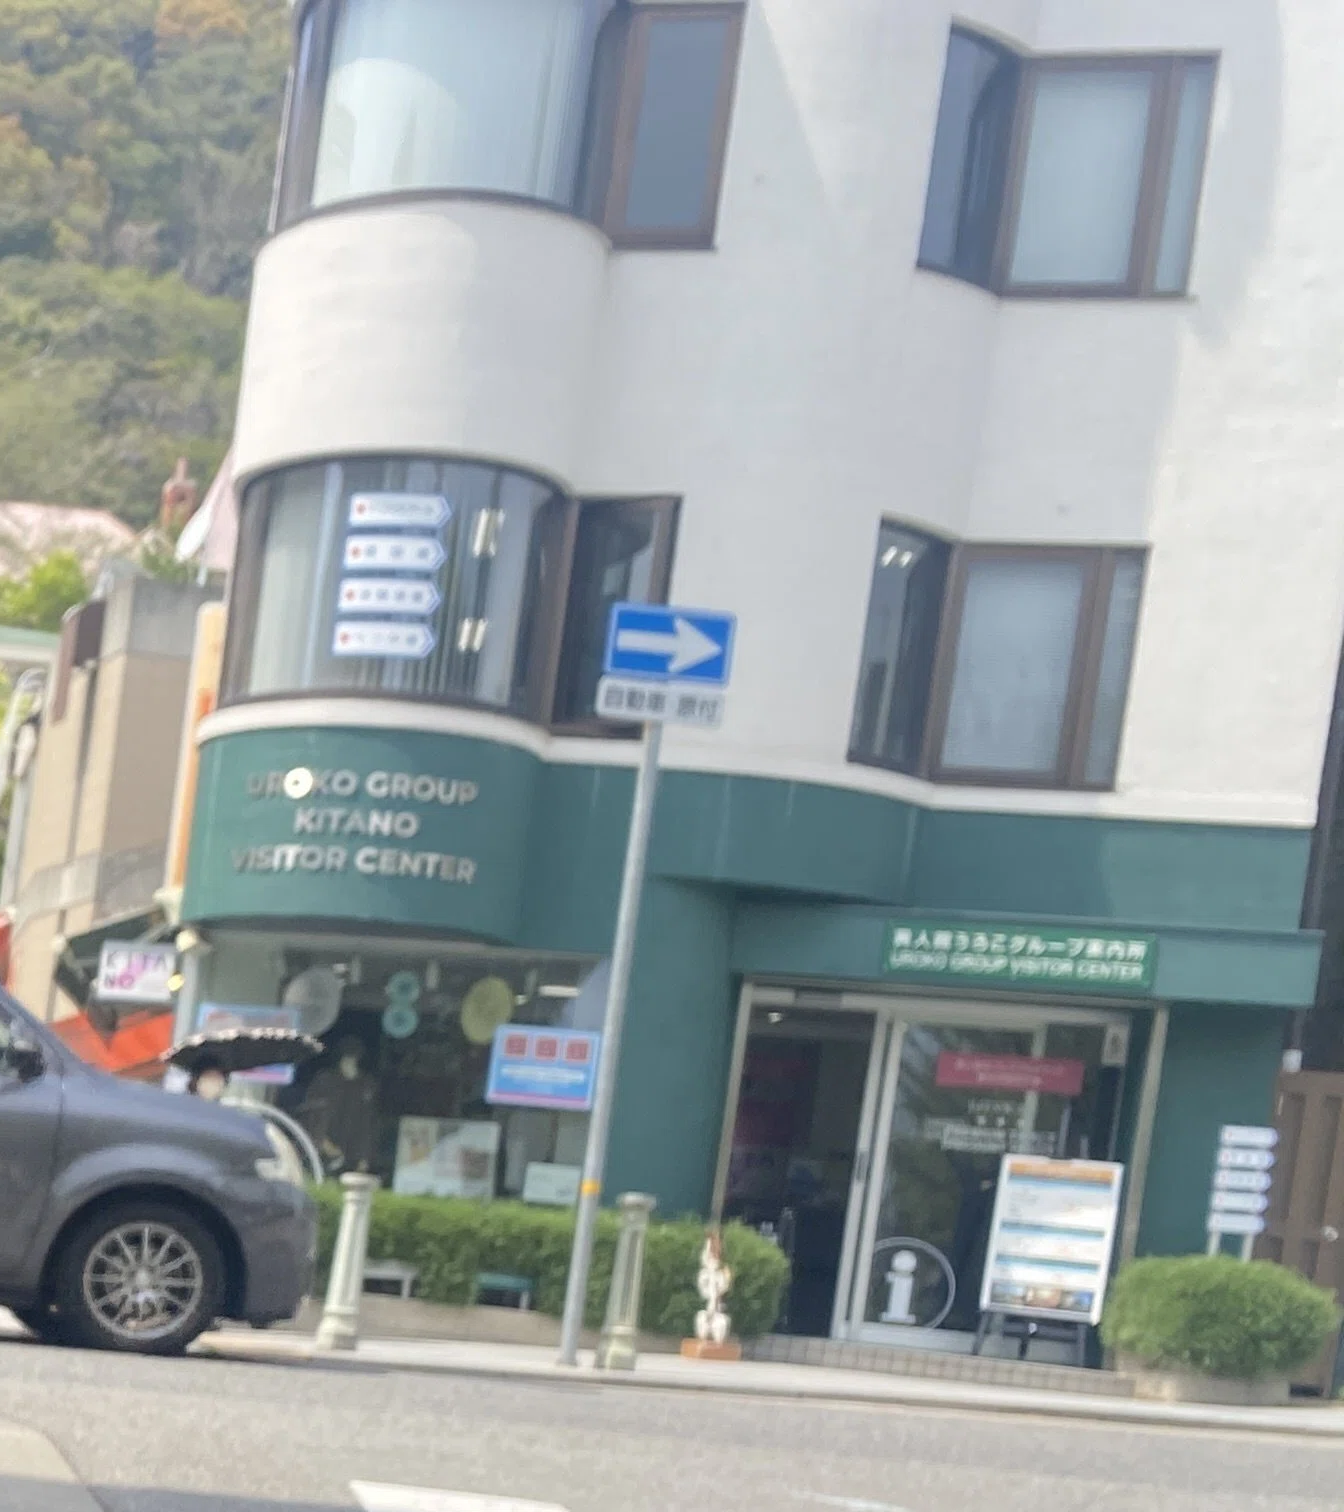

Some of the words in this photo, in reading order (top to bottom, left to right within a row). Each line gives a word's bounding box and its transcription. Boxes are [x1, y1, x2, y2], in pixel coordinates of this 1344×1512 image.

[365, 770, 479, 806] GROUP
[293, 806, 421, 839] KITANO
[231, 844, 346, 874] VISITOR
[353, 846, 477, 884] CENTER
